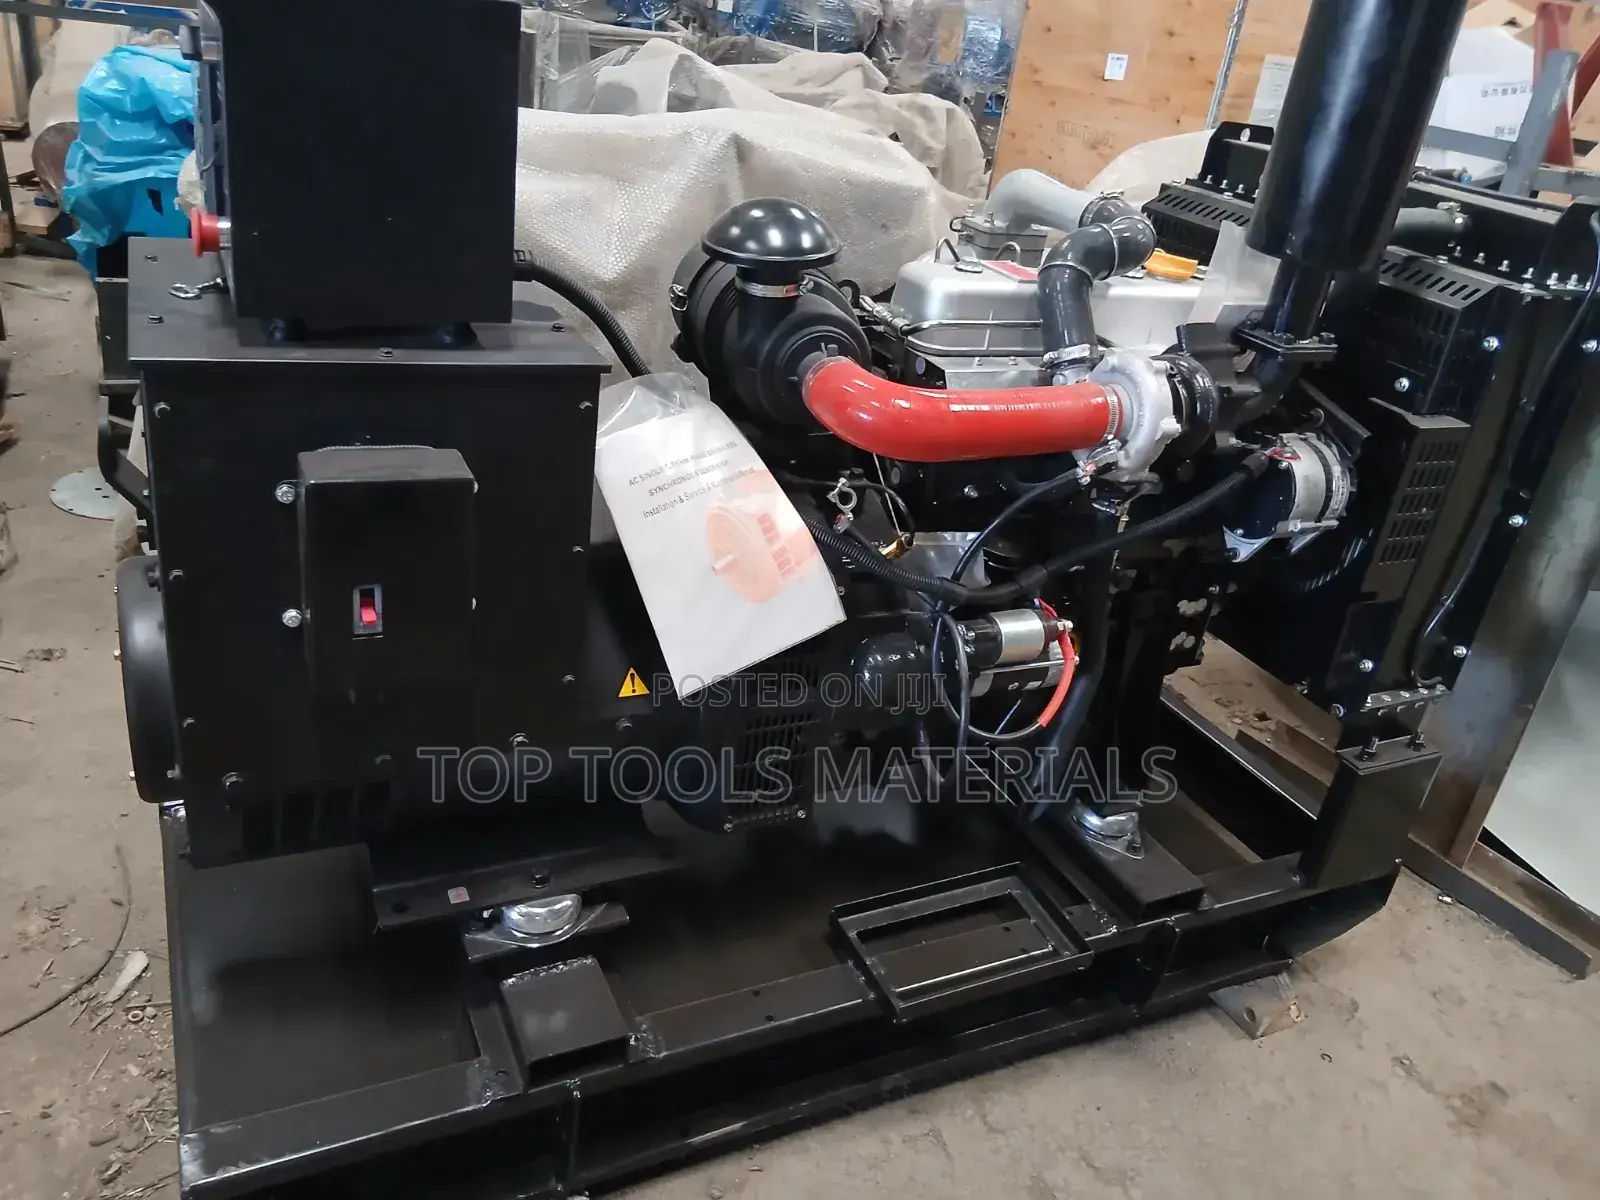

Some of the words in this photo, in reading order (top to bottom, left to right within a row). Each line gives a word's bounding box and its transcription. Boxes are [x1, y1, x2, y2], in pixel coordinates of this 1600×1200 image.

[628, 476, 639, 487] AC
[639, 465, 665, 482] SINGLE
[648, 469, 699, 497] SYNCHRONOUS
[642, 499, 679, 519] Installation
